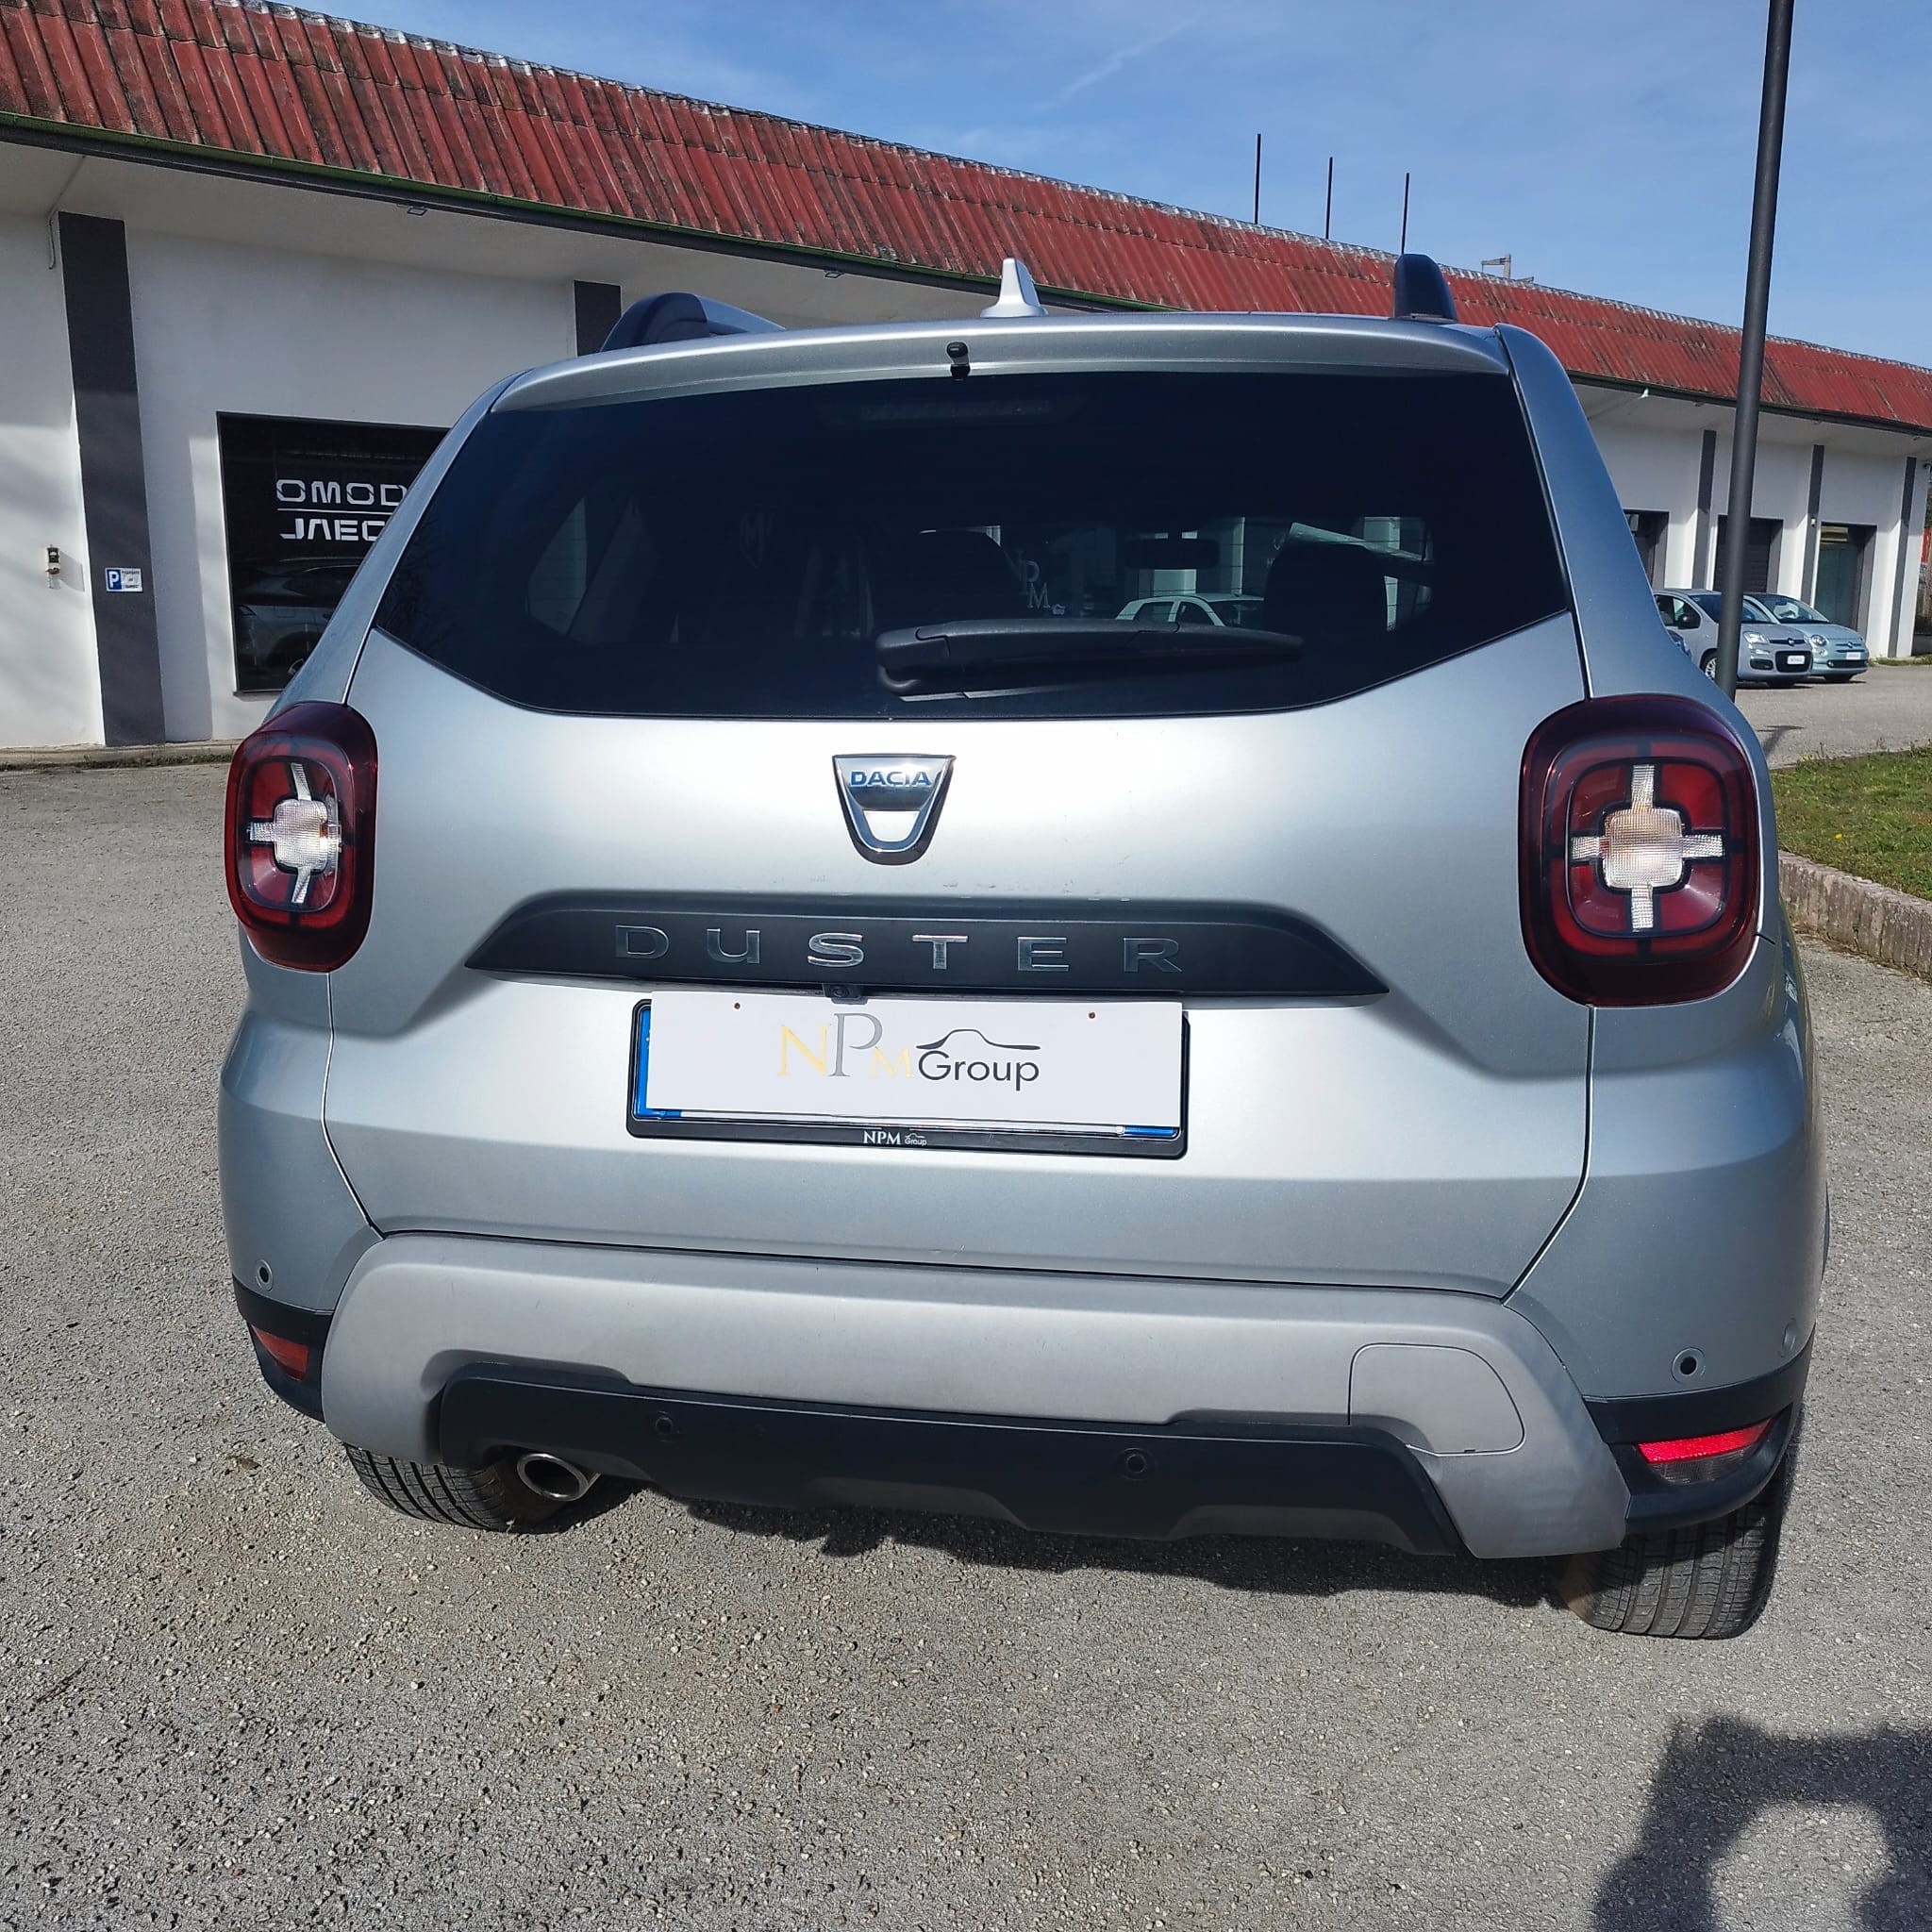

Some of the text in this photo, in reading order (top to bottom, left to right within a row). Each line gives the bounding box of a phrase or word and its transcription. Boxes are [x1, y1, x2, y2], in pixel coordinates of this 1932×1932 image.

[277, 479, 408, 506] OMOD
[108, 571, 119, 588] P
[851, 771, 932, 786] DACIA
[615, 924, 1183, 974] DUSTER
[917, 1049, 1040, 1091] Group
[863, 1131, 927, 1146] NPM Group
